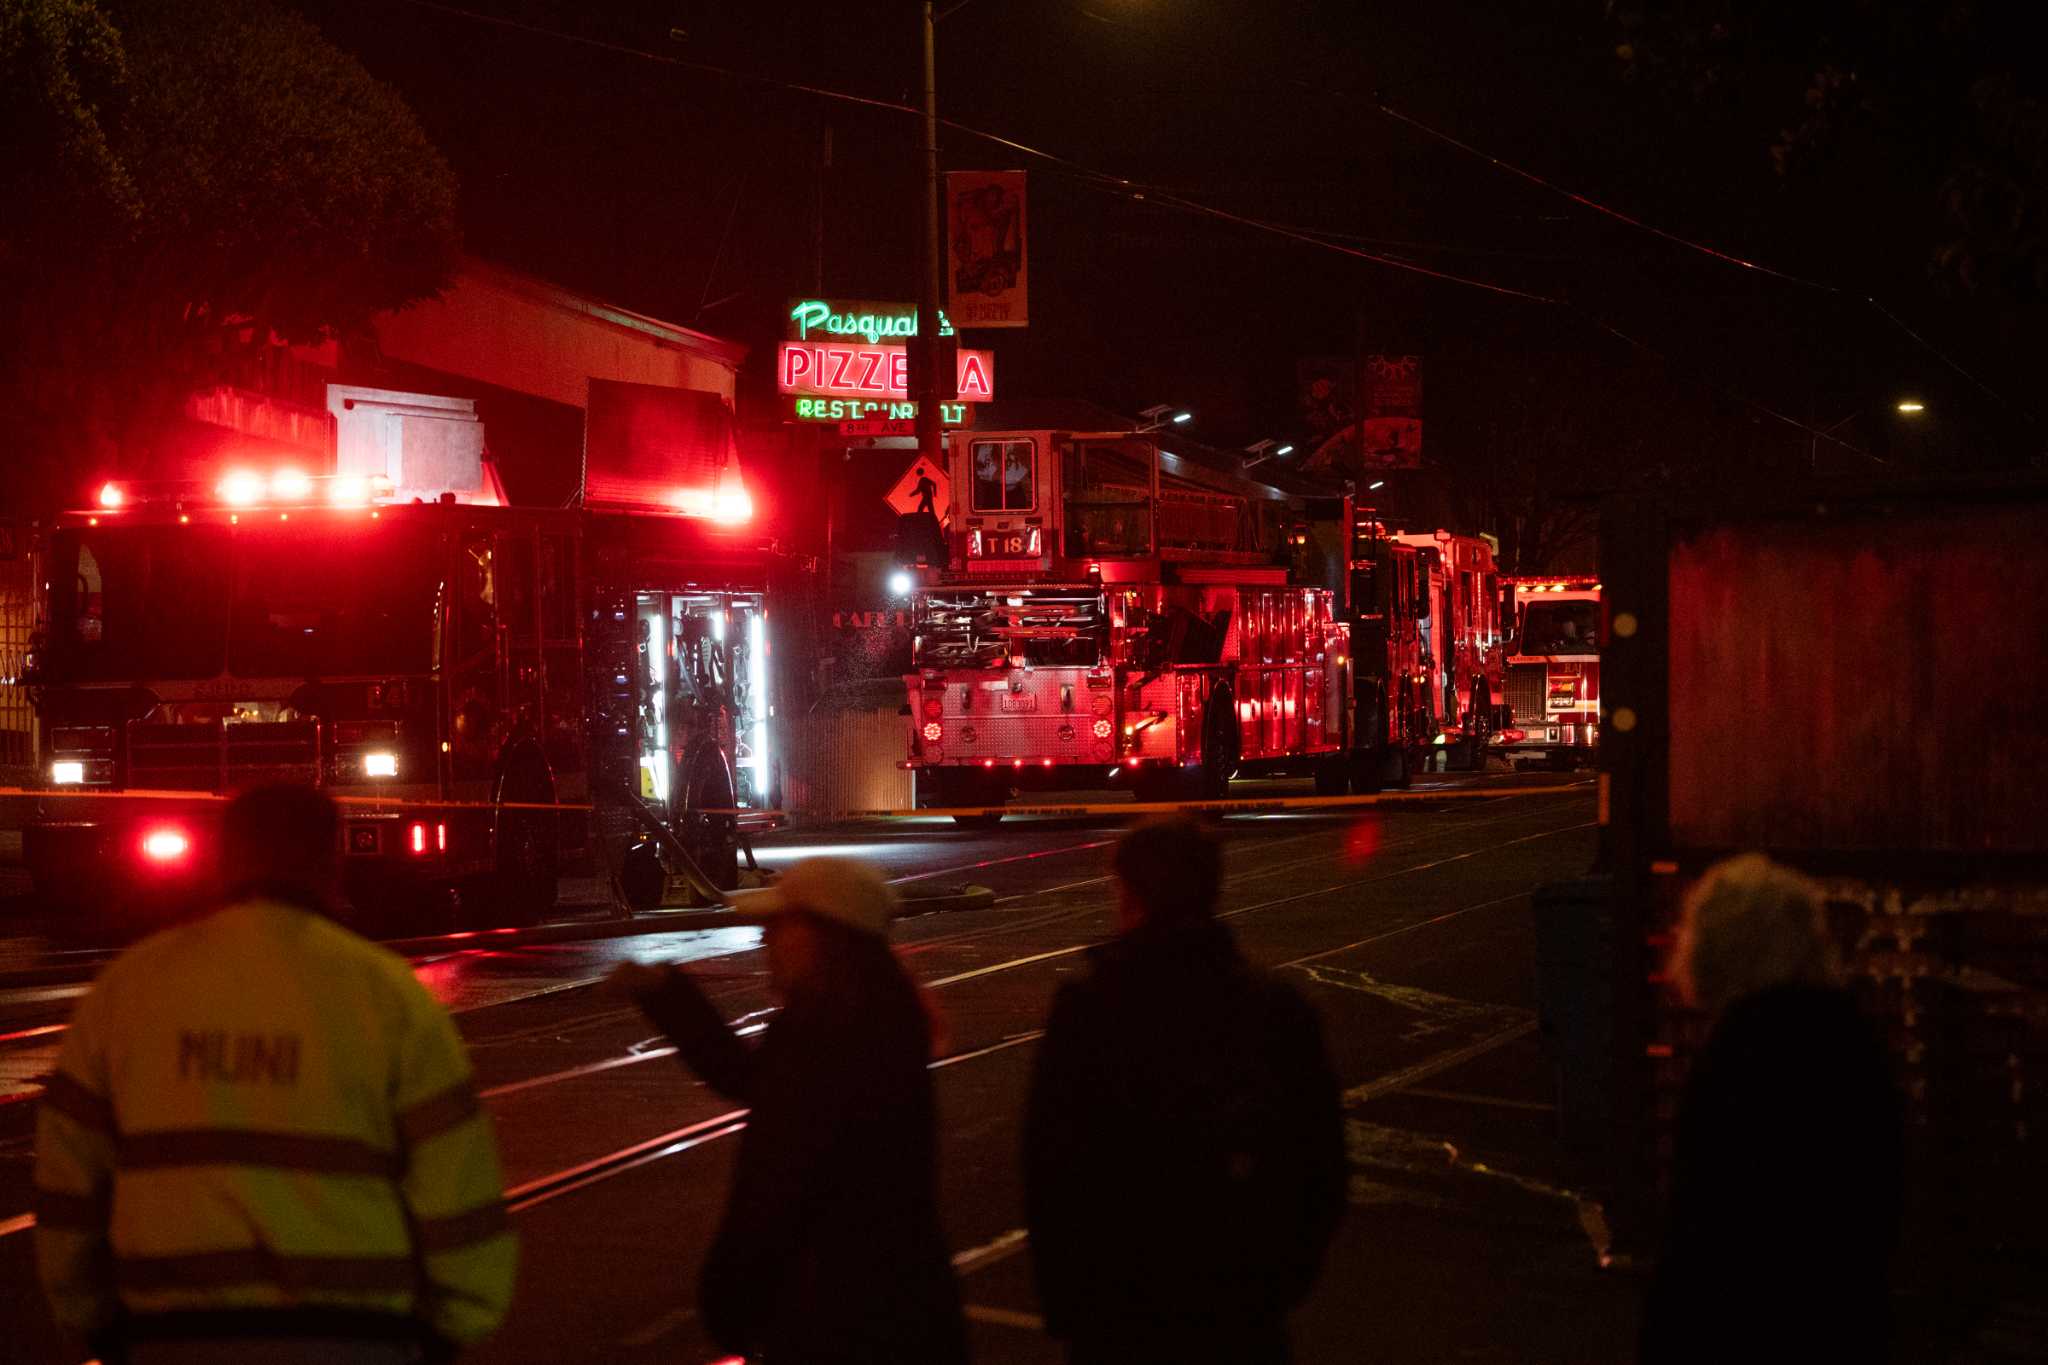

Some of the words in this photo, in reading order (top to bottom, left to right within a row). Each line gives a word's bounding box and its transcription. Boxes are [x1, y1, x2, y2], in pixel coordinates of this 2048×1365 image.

[784, 347, 990, 394] PIZZEA
[987, 537, 998, 553] T
[1004, 537, 1022, 553] 18
[177, 1029, 301, 1085] MUNI
